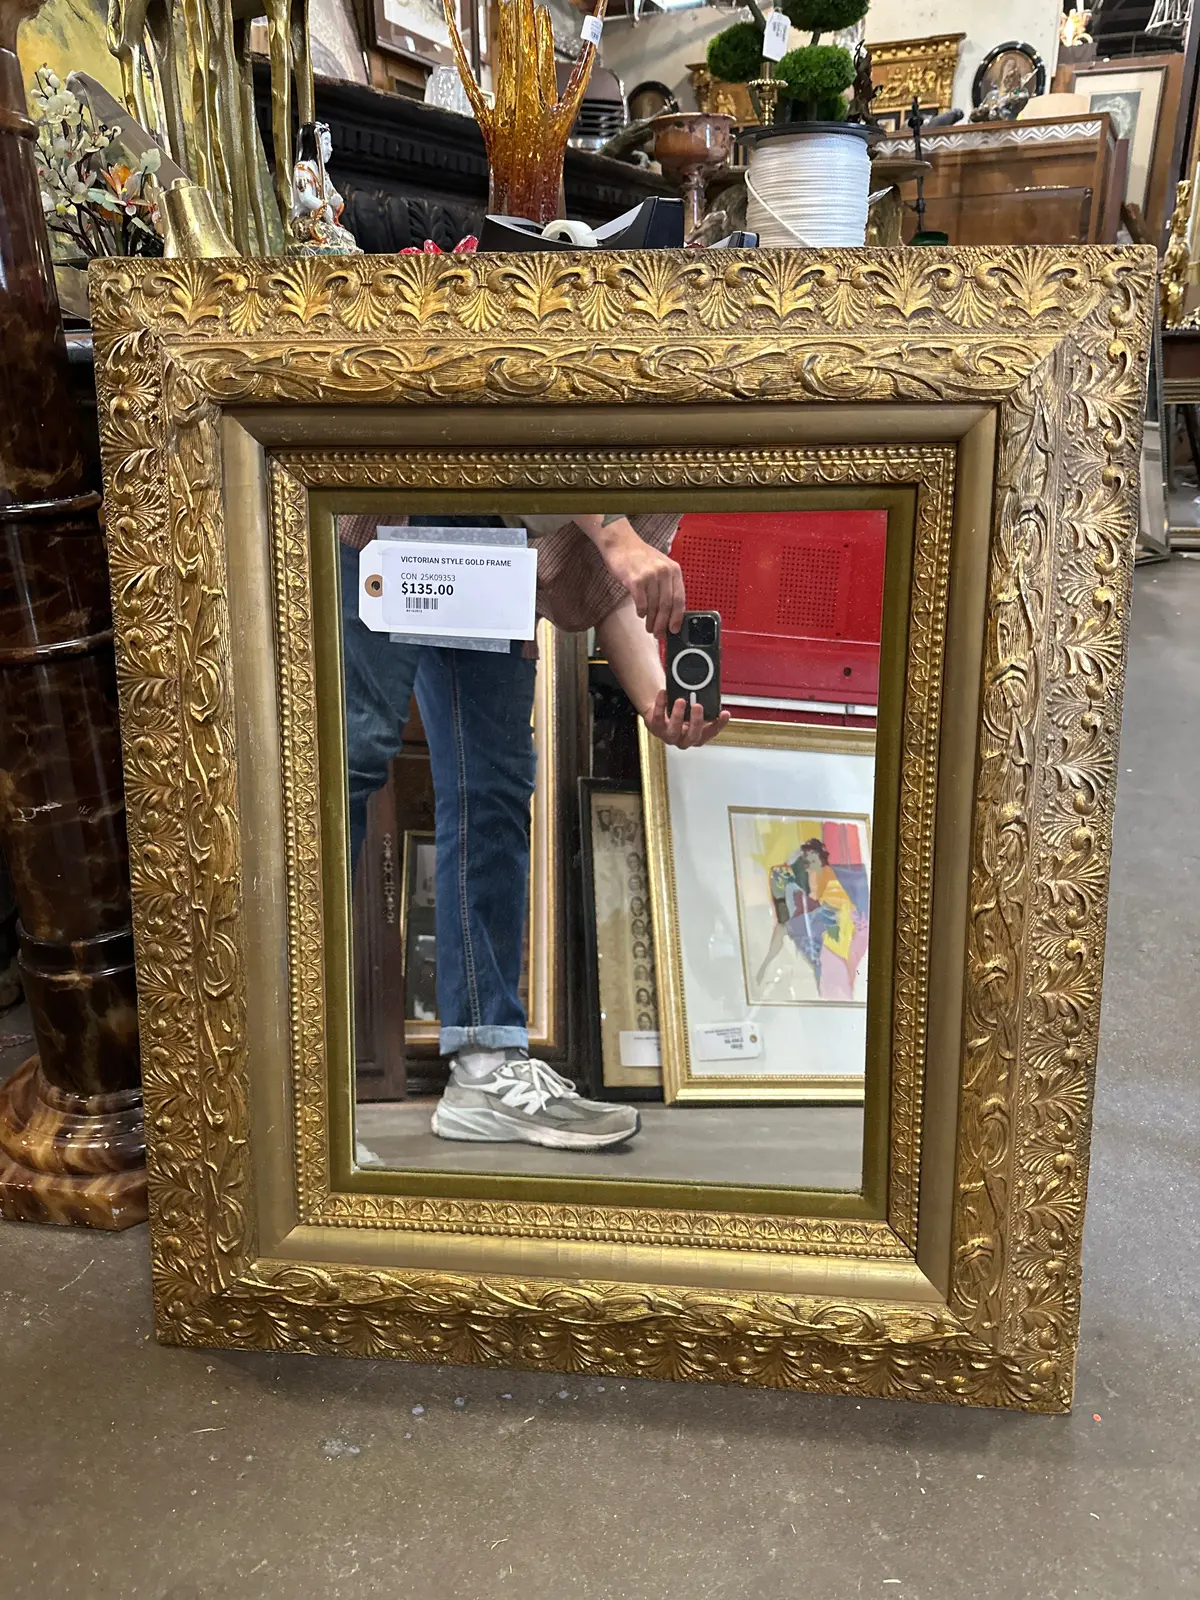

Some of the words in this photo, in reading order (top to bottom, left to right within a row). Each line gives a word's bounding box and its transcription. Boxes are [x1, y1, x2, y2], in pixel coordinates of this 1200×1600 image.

[400, 556, 440, 565] VICTORIAN
[441, 557, 464, 565] STYLE
[465, 558, 485, 566] GOLD
[486, 559, 512, 567] FRAME
[400, 572, 418, 580] CON
[420, 573, 456, 582] 25K09353
[401, 581, 454, 596] $135.00
